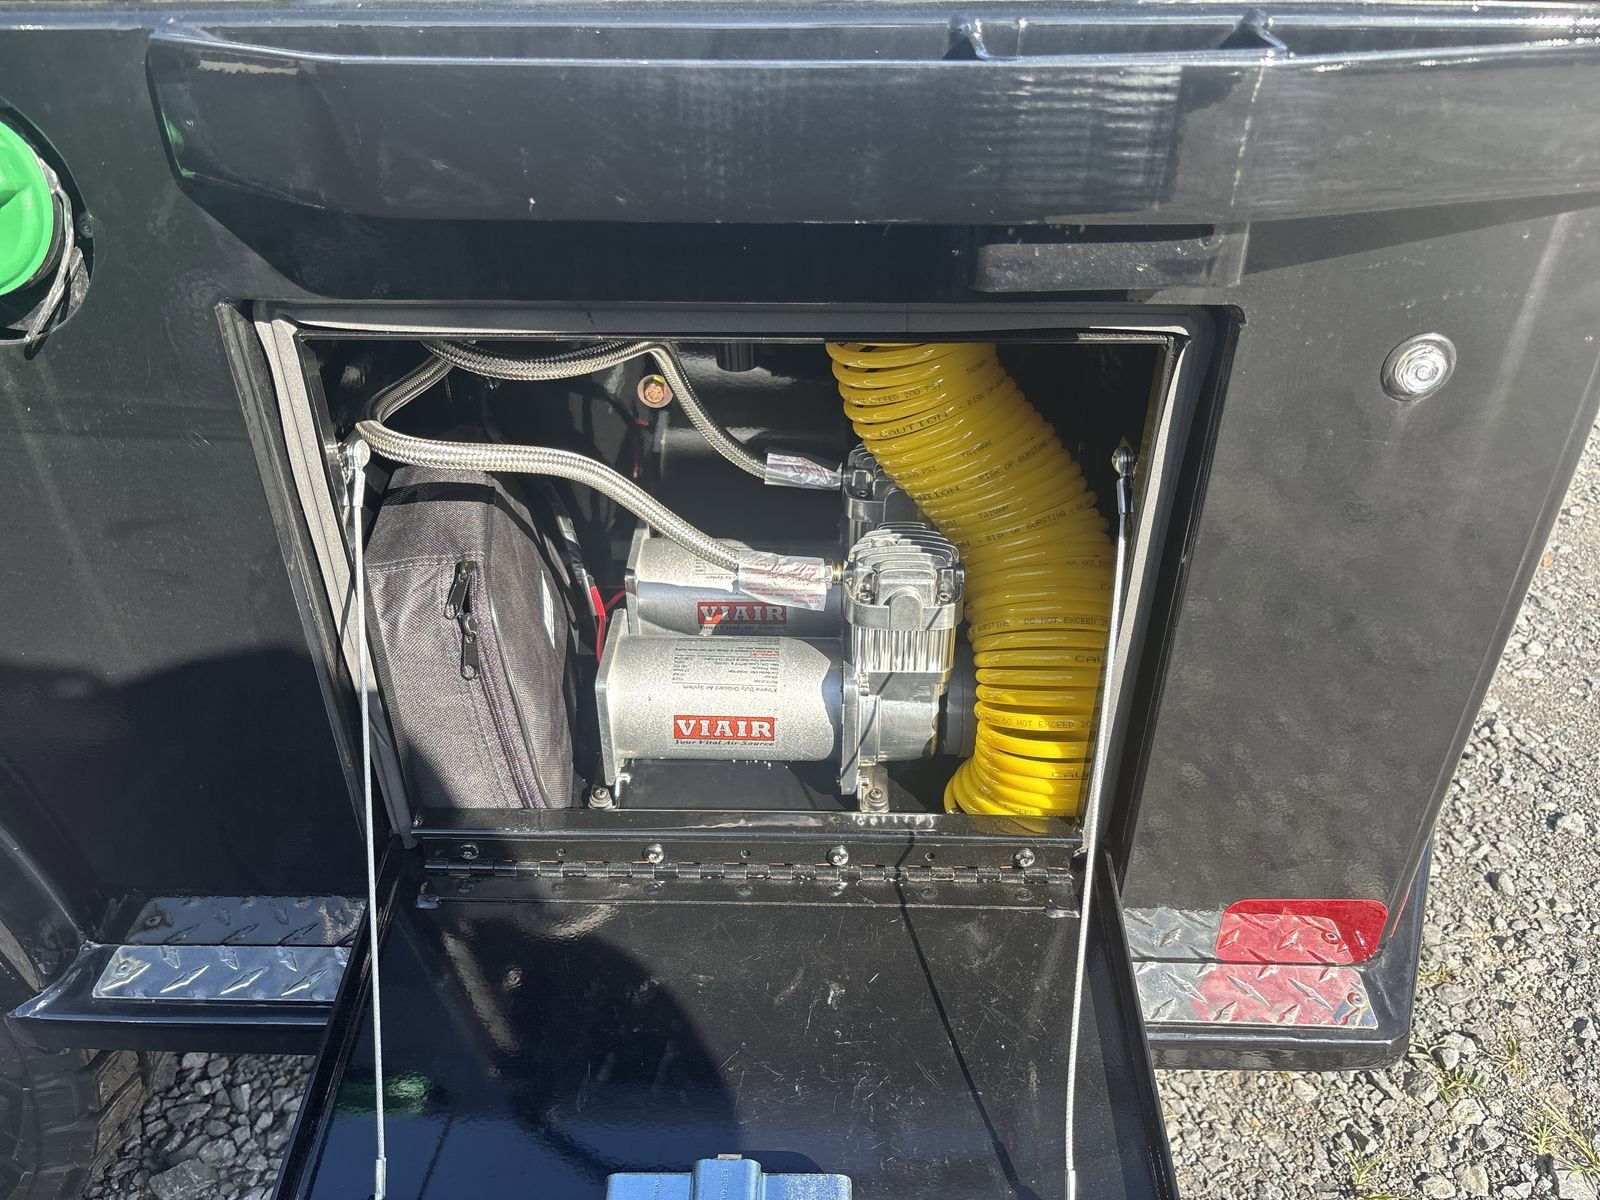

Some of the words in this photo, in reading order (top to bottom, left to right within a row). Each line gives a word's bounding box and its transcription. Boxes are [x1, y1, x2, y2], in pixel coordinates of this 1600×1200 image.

[699, 605, 784, 622] VIAIR
[1063, 617, 1097, 625] EXCEED
[675, 718, 773, 738] VIAIR
[1017, 719, 1033, 727] NOT
[1038, 720, 1075, 729] EXCEED
